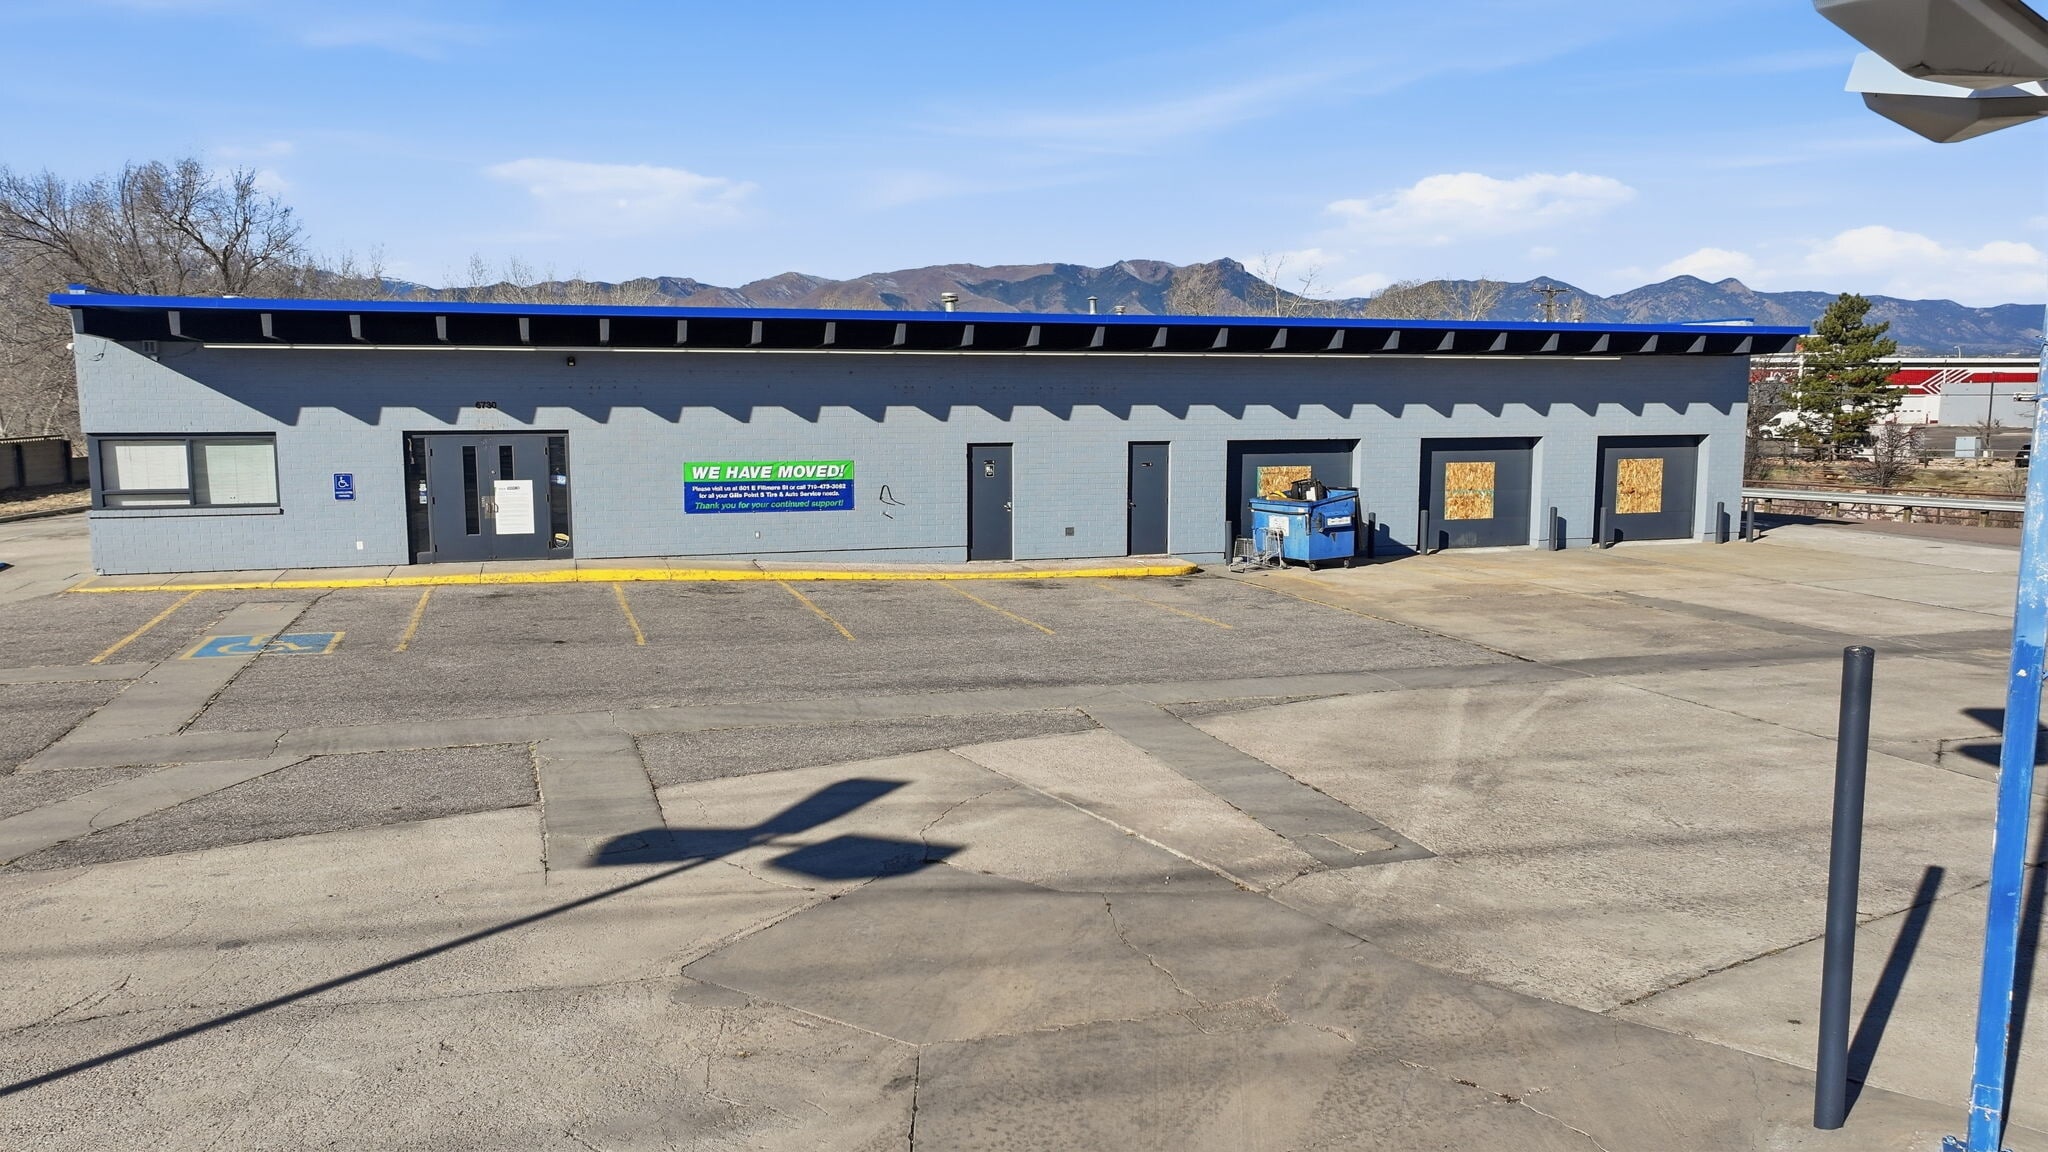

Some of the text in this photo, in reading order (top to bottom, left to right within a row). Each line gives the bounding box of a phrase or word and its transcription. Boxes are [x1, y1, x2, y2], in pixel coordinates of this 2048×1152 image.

[475, 401, 497, 409] 6730
[692, 464, 847, 480] WE HAVE MOVED!
[695, 501, 720, 509] Thank
[721, 502, 737, 510] you
[738, 500, 750, 509] for
[770, 499, 810, 508] continued
[811, 499, 844, 508] support!
